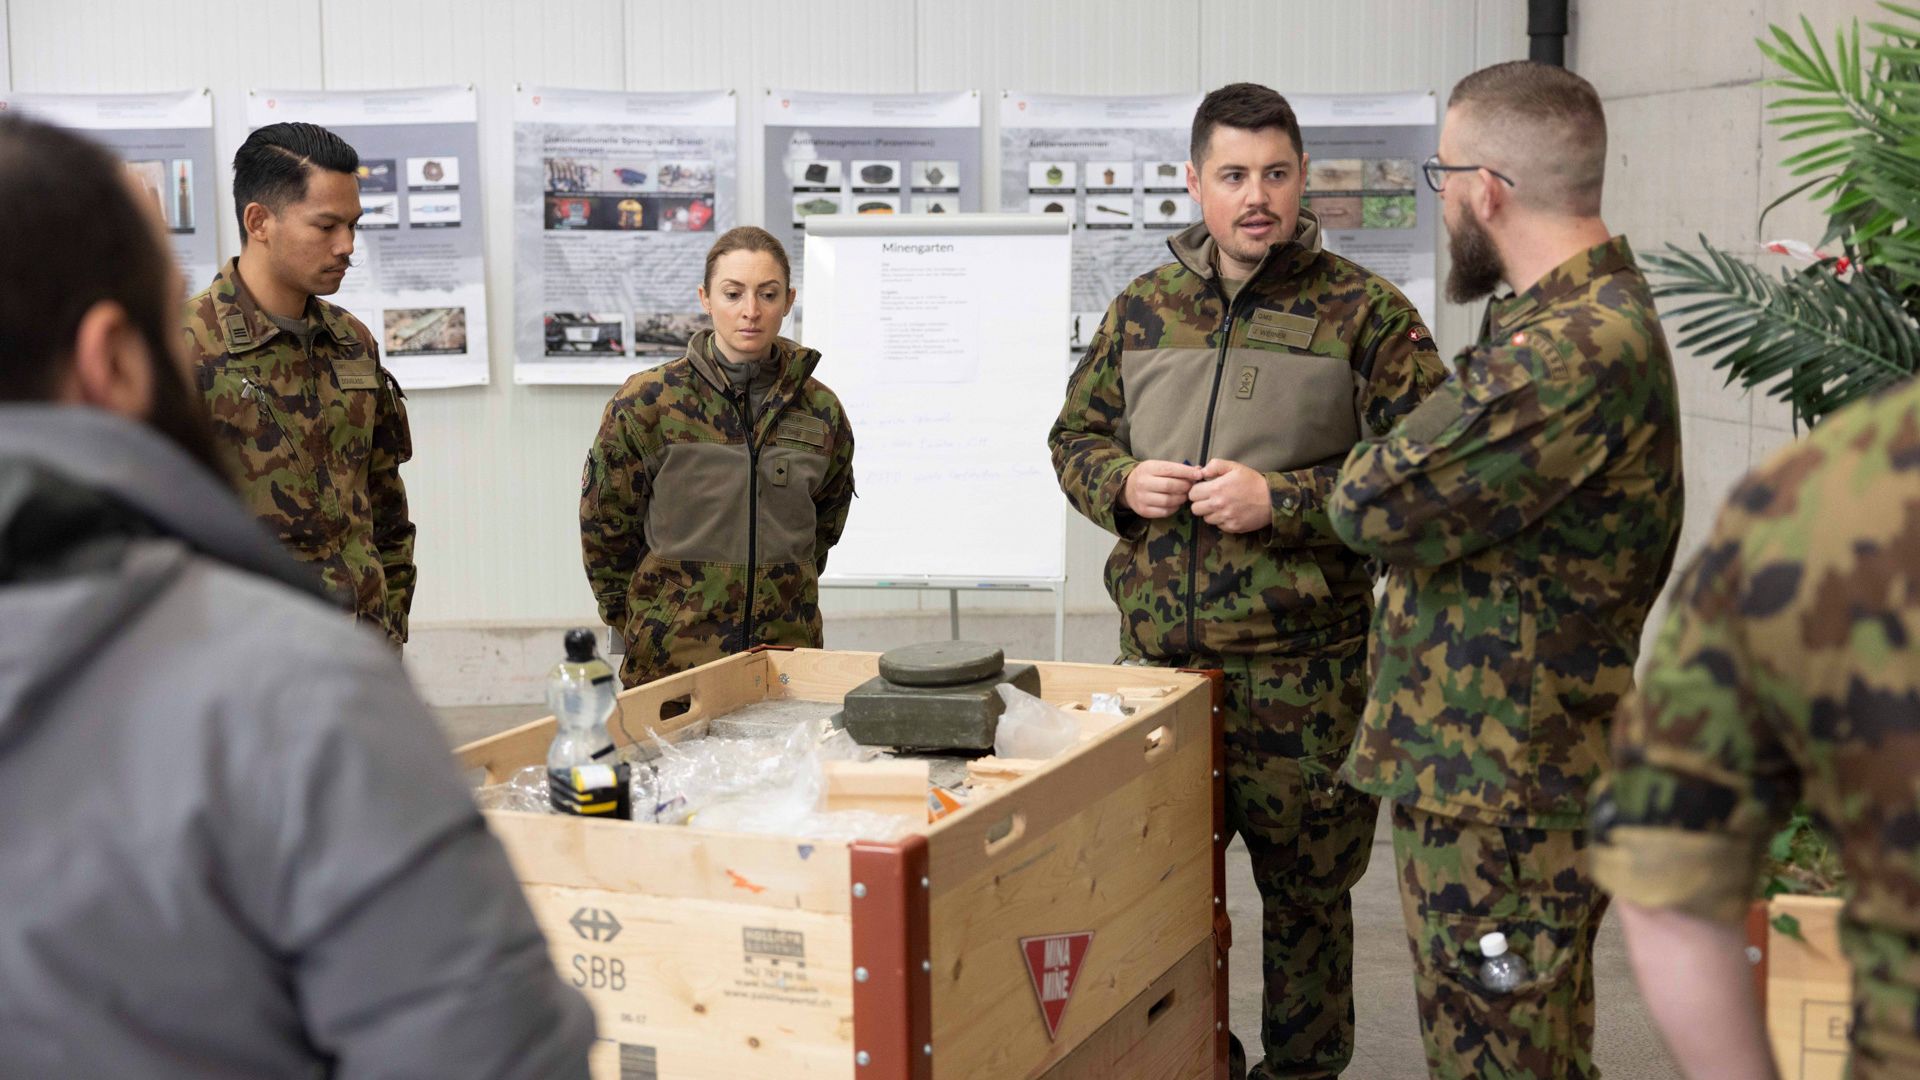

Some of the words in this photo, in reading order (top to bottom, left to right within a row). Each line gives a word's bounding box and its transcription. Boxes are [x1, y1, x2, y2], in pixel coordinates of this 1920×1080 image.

[882, 242, 954, 255] Minengarten
[1044, 938, 1070, 968] MINA
[572, 953, 626, 991] SBB
[1042, 969, 1069, 1001] MINE
